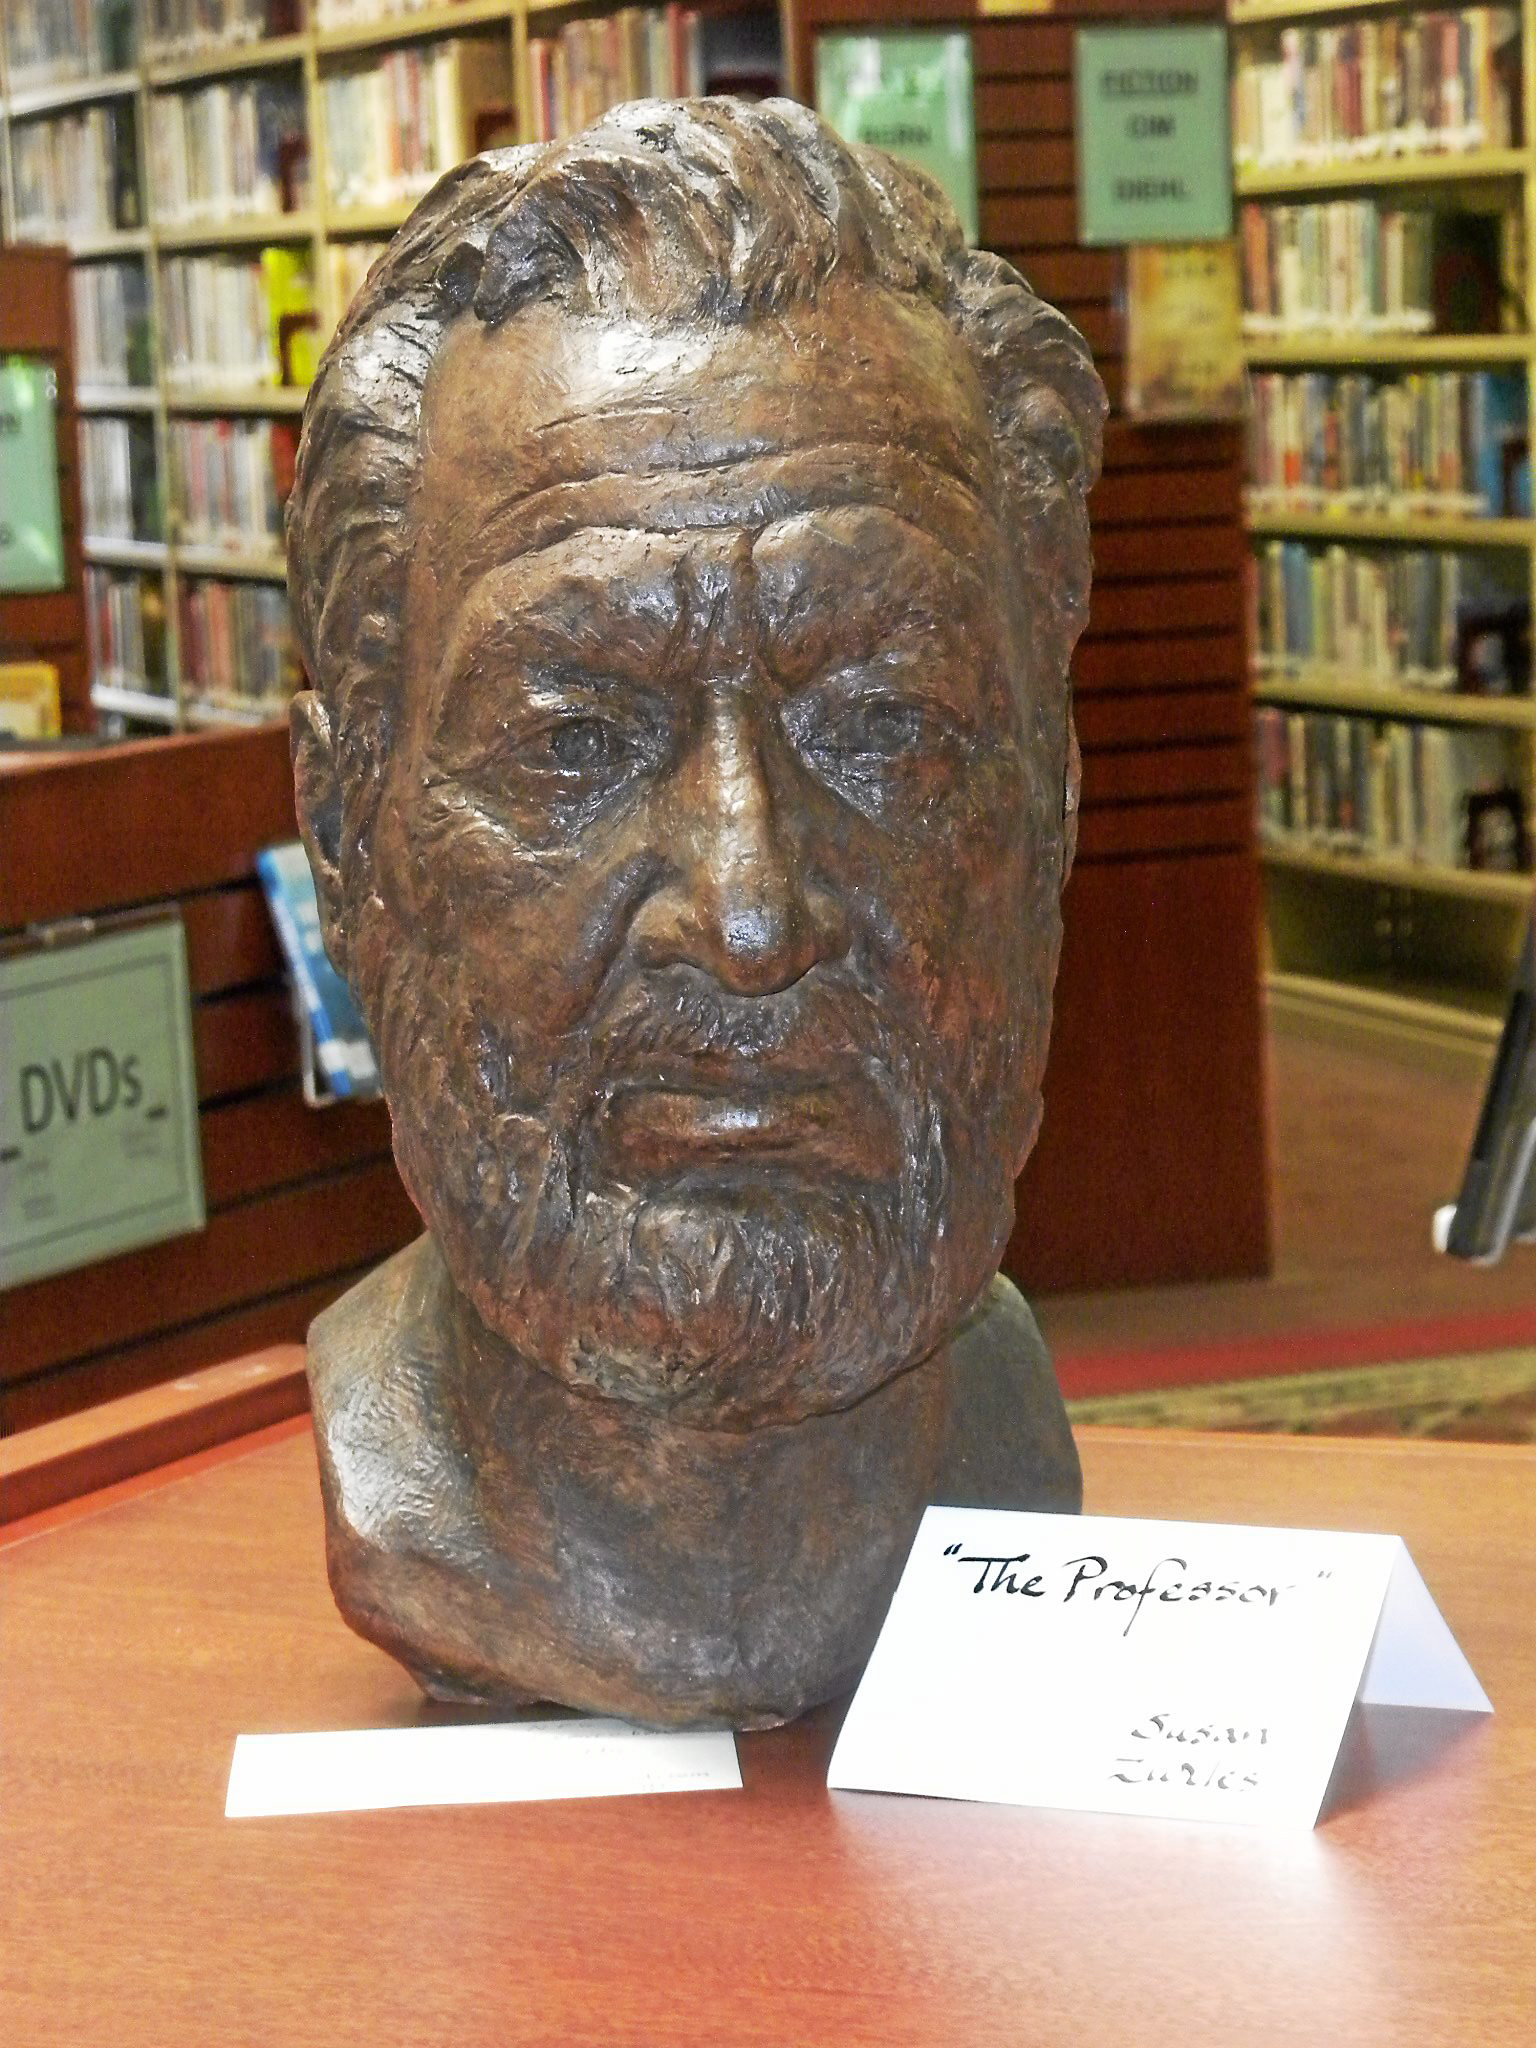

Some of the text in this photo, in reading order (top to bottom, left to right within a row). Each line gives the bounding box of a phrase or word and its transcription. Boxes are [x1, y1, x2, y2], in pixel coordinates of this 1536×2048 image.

[1102, 70, 1198, 93] FICTION
[20, 1047, 142, 1134] DVDs
[1131, 1713, 1268, 1745] Susan
